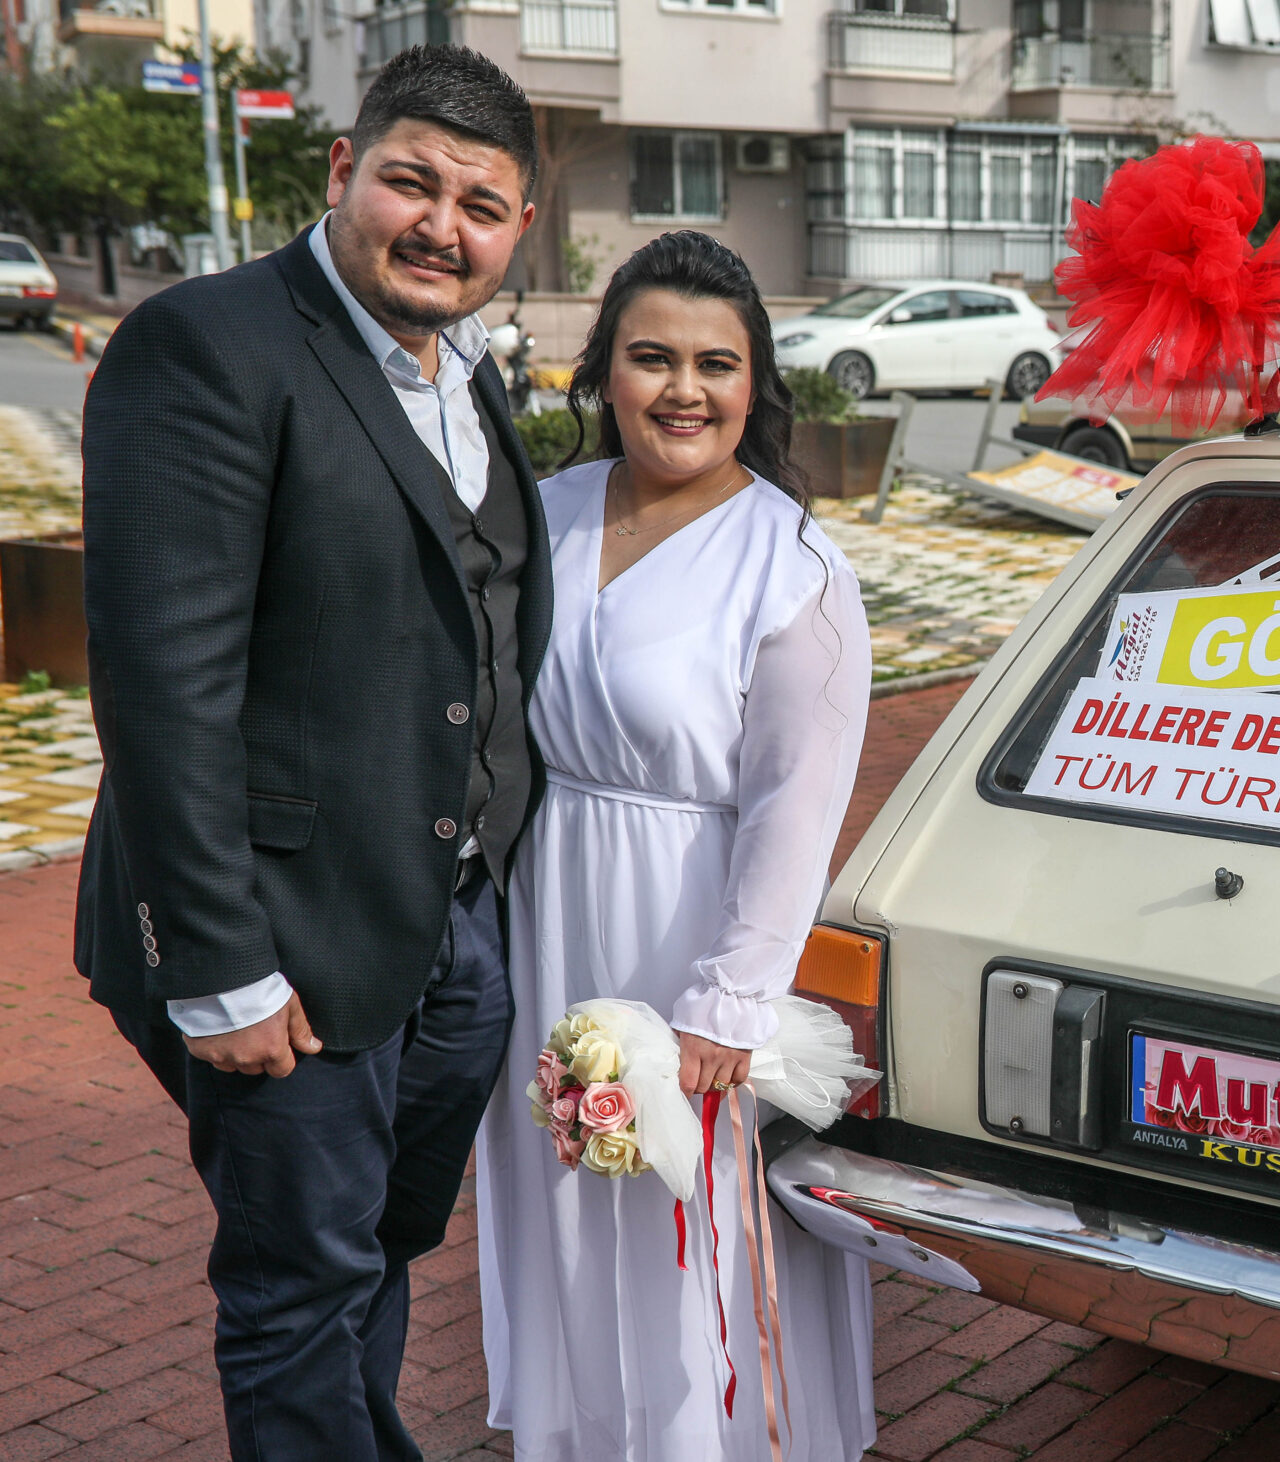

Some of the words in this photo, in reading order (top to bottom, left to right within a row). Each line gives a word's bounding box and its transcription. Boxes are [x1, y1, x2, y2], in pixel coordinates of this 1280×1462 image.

[1145, 627, 1153, 639] 27
[1072, 692, 1232, 747] DİLLERE
[1054, 753, 1158, 796] TÜM
[1133, 1129, 1188, 1150] ANTALYA
